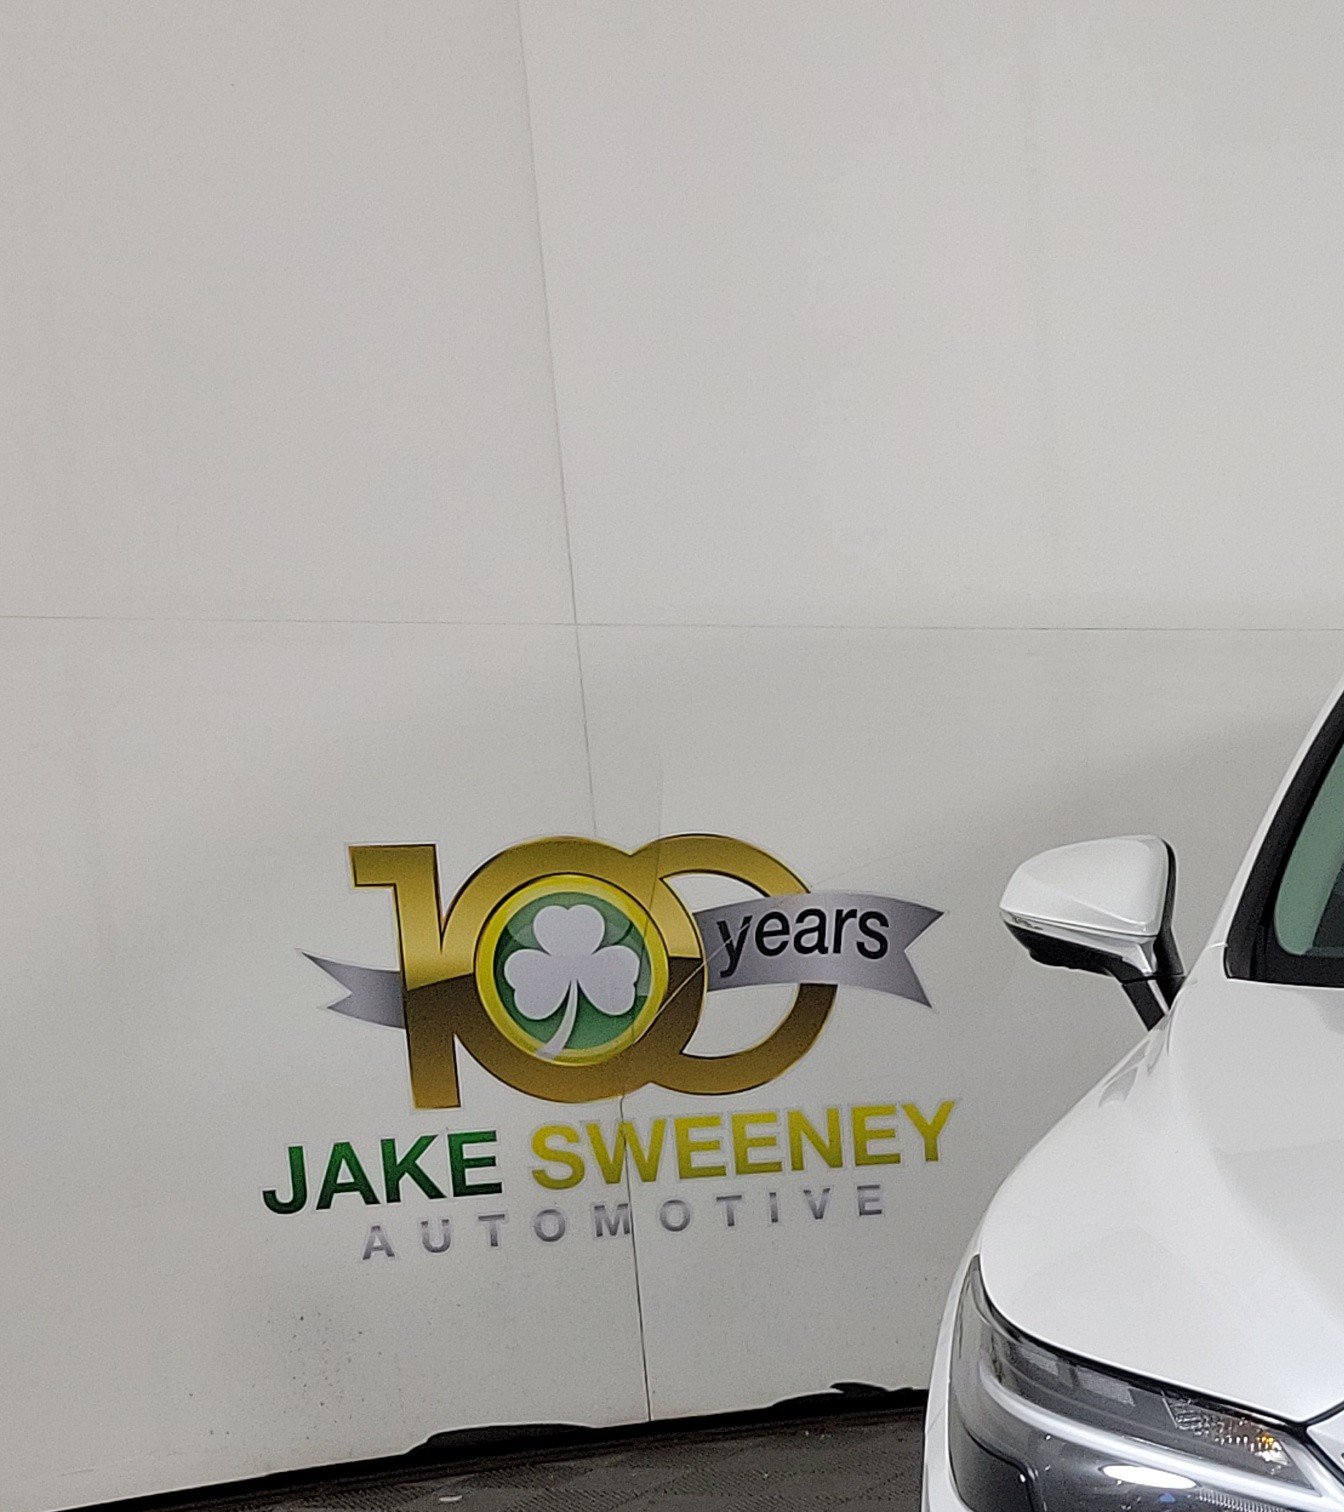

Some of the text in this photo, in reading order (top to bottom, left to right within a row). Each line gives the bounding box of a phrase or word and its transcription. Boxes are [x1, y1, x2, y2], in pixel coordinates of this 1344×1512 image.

[716, 908, 891, 978] years
[262, 1101, 955, 1215] JAKE SWEENEY
[362, 1184, 884, 1261] AUTOMOTIVE
